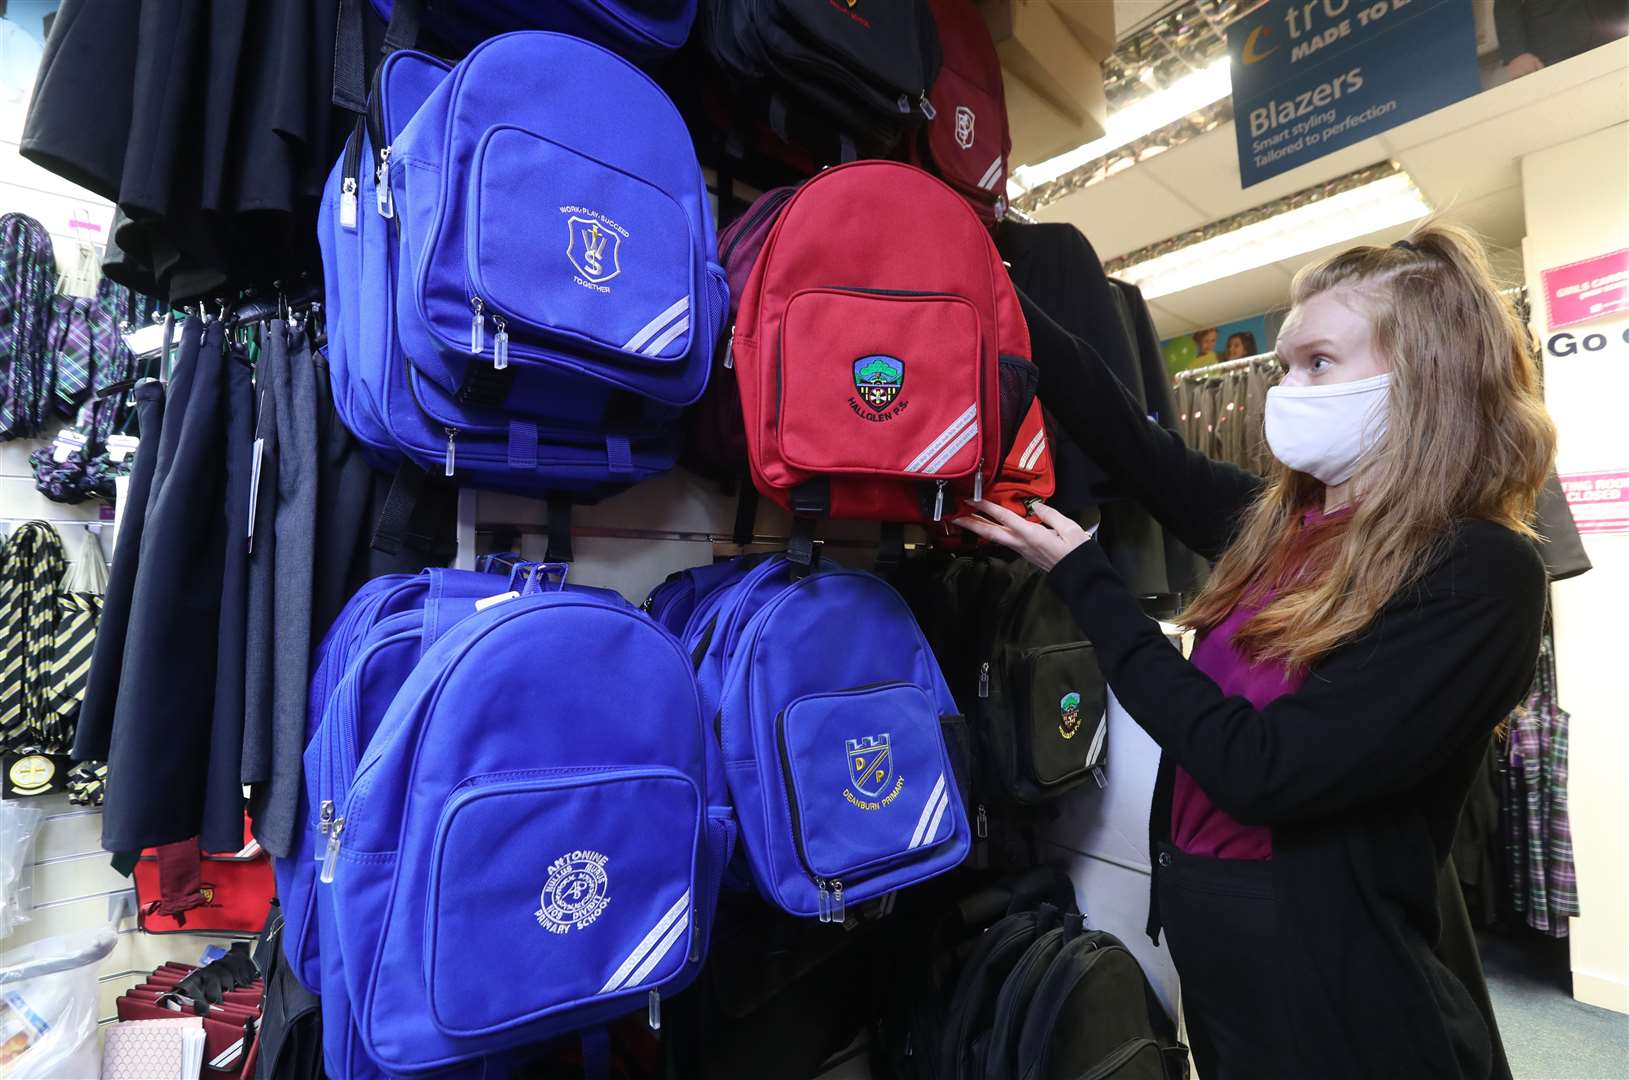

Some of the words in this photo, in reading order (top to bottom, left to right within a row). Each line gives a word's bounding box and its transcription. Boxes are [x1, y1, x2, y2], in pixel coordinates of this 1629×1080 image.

[1291, 19, 1352, 64] MADE
[1357, 1, 1389, 27] TO
[1250, 67, 1364, 138] Blazers
[1253, 127, 1290, 153] Smart
[1292, 108, 1337, 135] styling
[1254, 137, 1304, 168] Tailored
[1305, 132, 1320, 147] to
[1322, 100, 1397, 143] perfection
[1547, 332, 1608, 357] Go
[847, 396, 893, 423] HALLGLEN
[1567, 490, 1621, 501] CLOSED
[842, 788, 880, 810] DEANBURN
[881, 775, 905, 807] PRIMARY
[546, 849, 609, 875] ANTONINE
[533, 908, 571, 935] PRIMARY
[576, 897, 612, 930] SCHOOL
